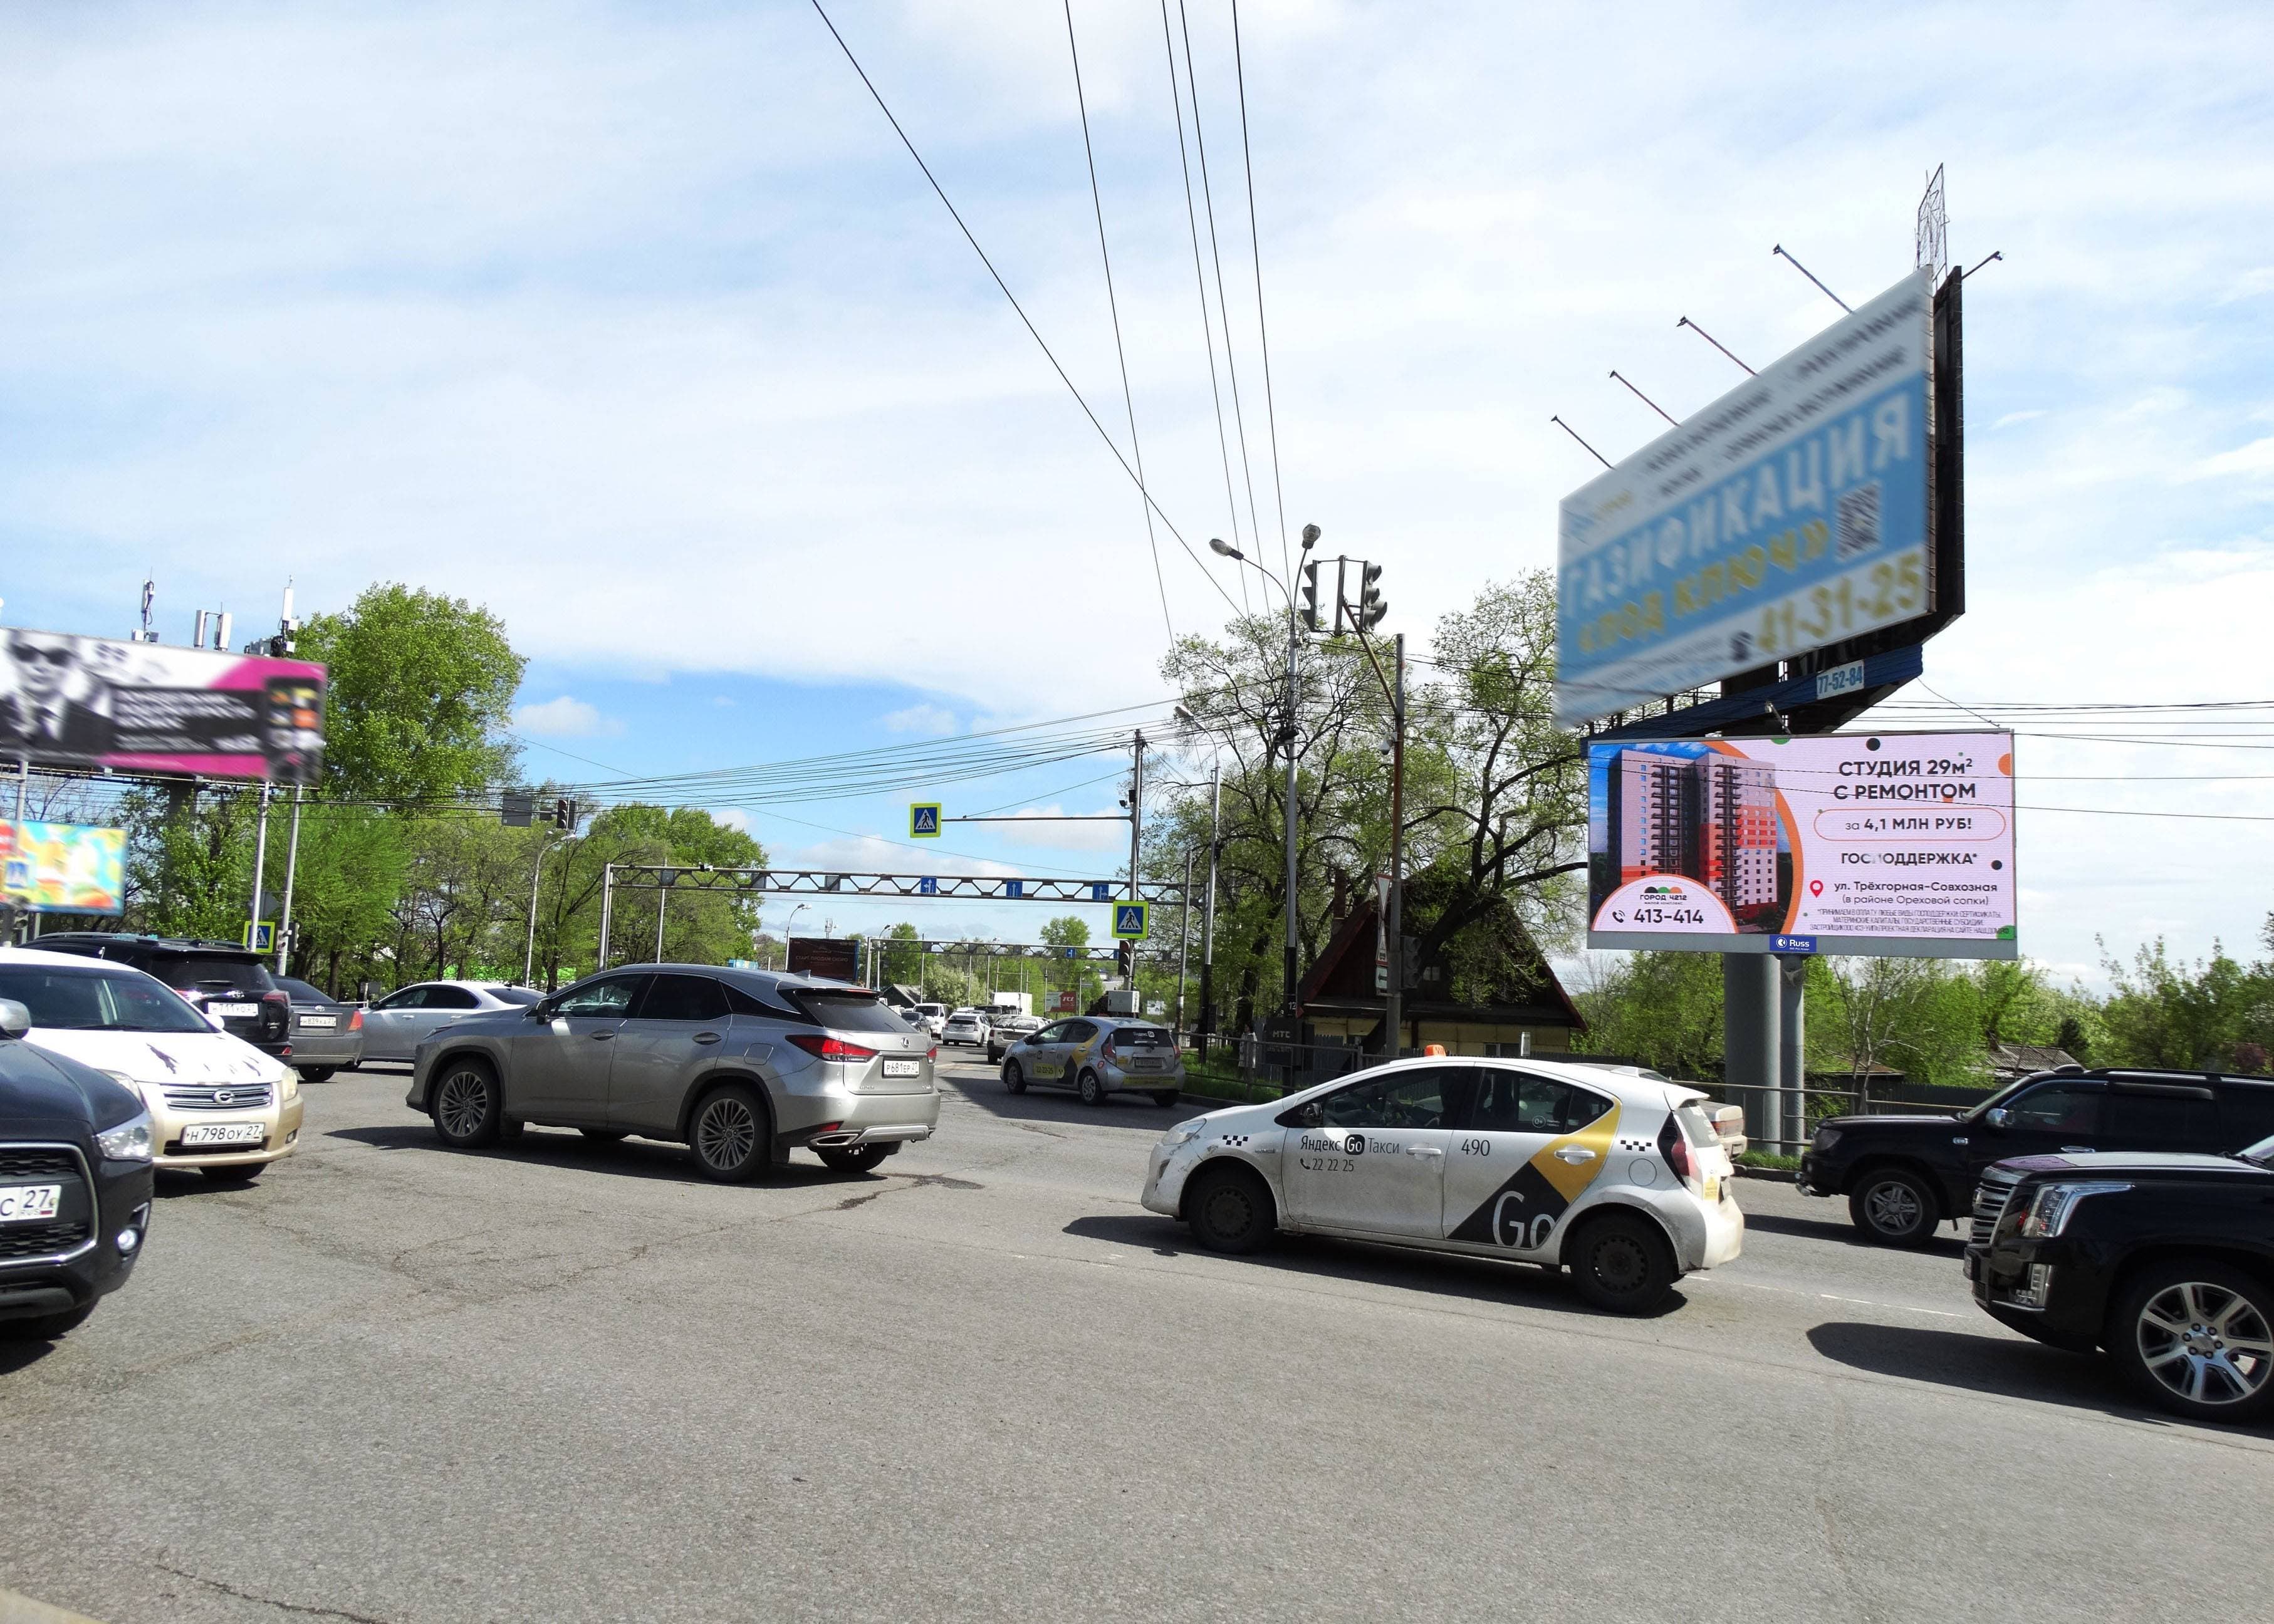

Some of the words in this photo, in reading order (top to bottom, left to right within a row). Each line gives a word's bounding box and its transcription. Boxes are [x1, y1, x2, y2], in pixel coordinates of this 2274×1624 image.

[1817, 665, 1863, 694] 77-52-84
[1838, 760, 1921, 778] СТУДИЯ
[1833, 785, 1848, 799] С
[1855, 783, 1976, 800] РЕМОНТОМ
[1845, 822, 1860, 830] за
[1864, 818, 1886, 832] 4,1
[1892, 818, 1929, 830] МЛН
[1935, 817, 1972, 830] РУБ!
[1834, 883, 1850, 892] ул.
[1854, 881, 1998, 892] Трёхгорная-Совхозная
[1842, 894, 1851, 903] (в
[1854, 895, 1894, 904] районе
[1896, 895, 1950, 905] Ореховой
[1953, 896, 1988, 905] сопки)
[1634, 908, 1704, 924] 413-414
[1300, 1135, 1341, 1152] Яндекс
[1347, 1137, 1362, 1152] Go
[1368, 1137, 1400, 1154] Такси
[1461, 1138, 1490, 1157] 490
[1312, 1158, 1323, 1171] 22
[1327, 1158, 1338, 1172] 22
[1342, 1159, 1354, 1172] 25
[23, 1189, 50, 1209] 27
[1492, 1190, 1556, 1249] Go
